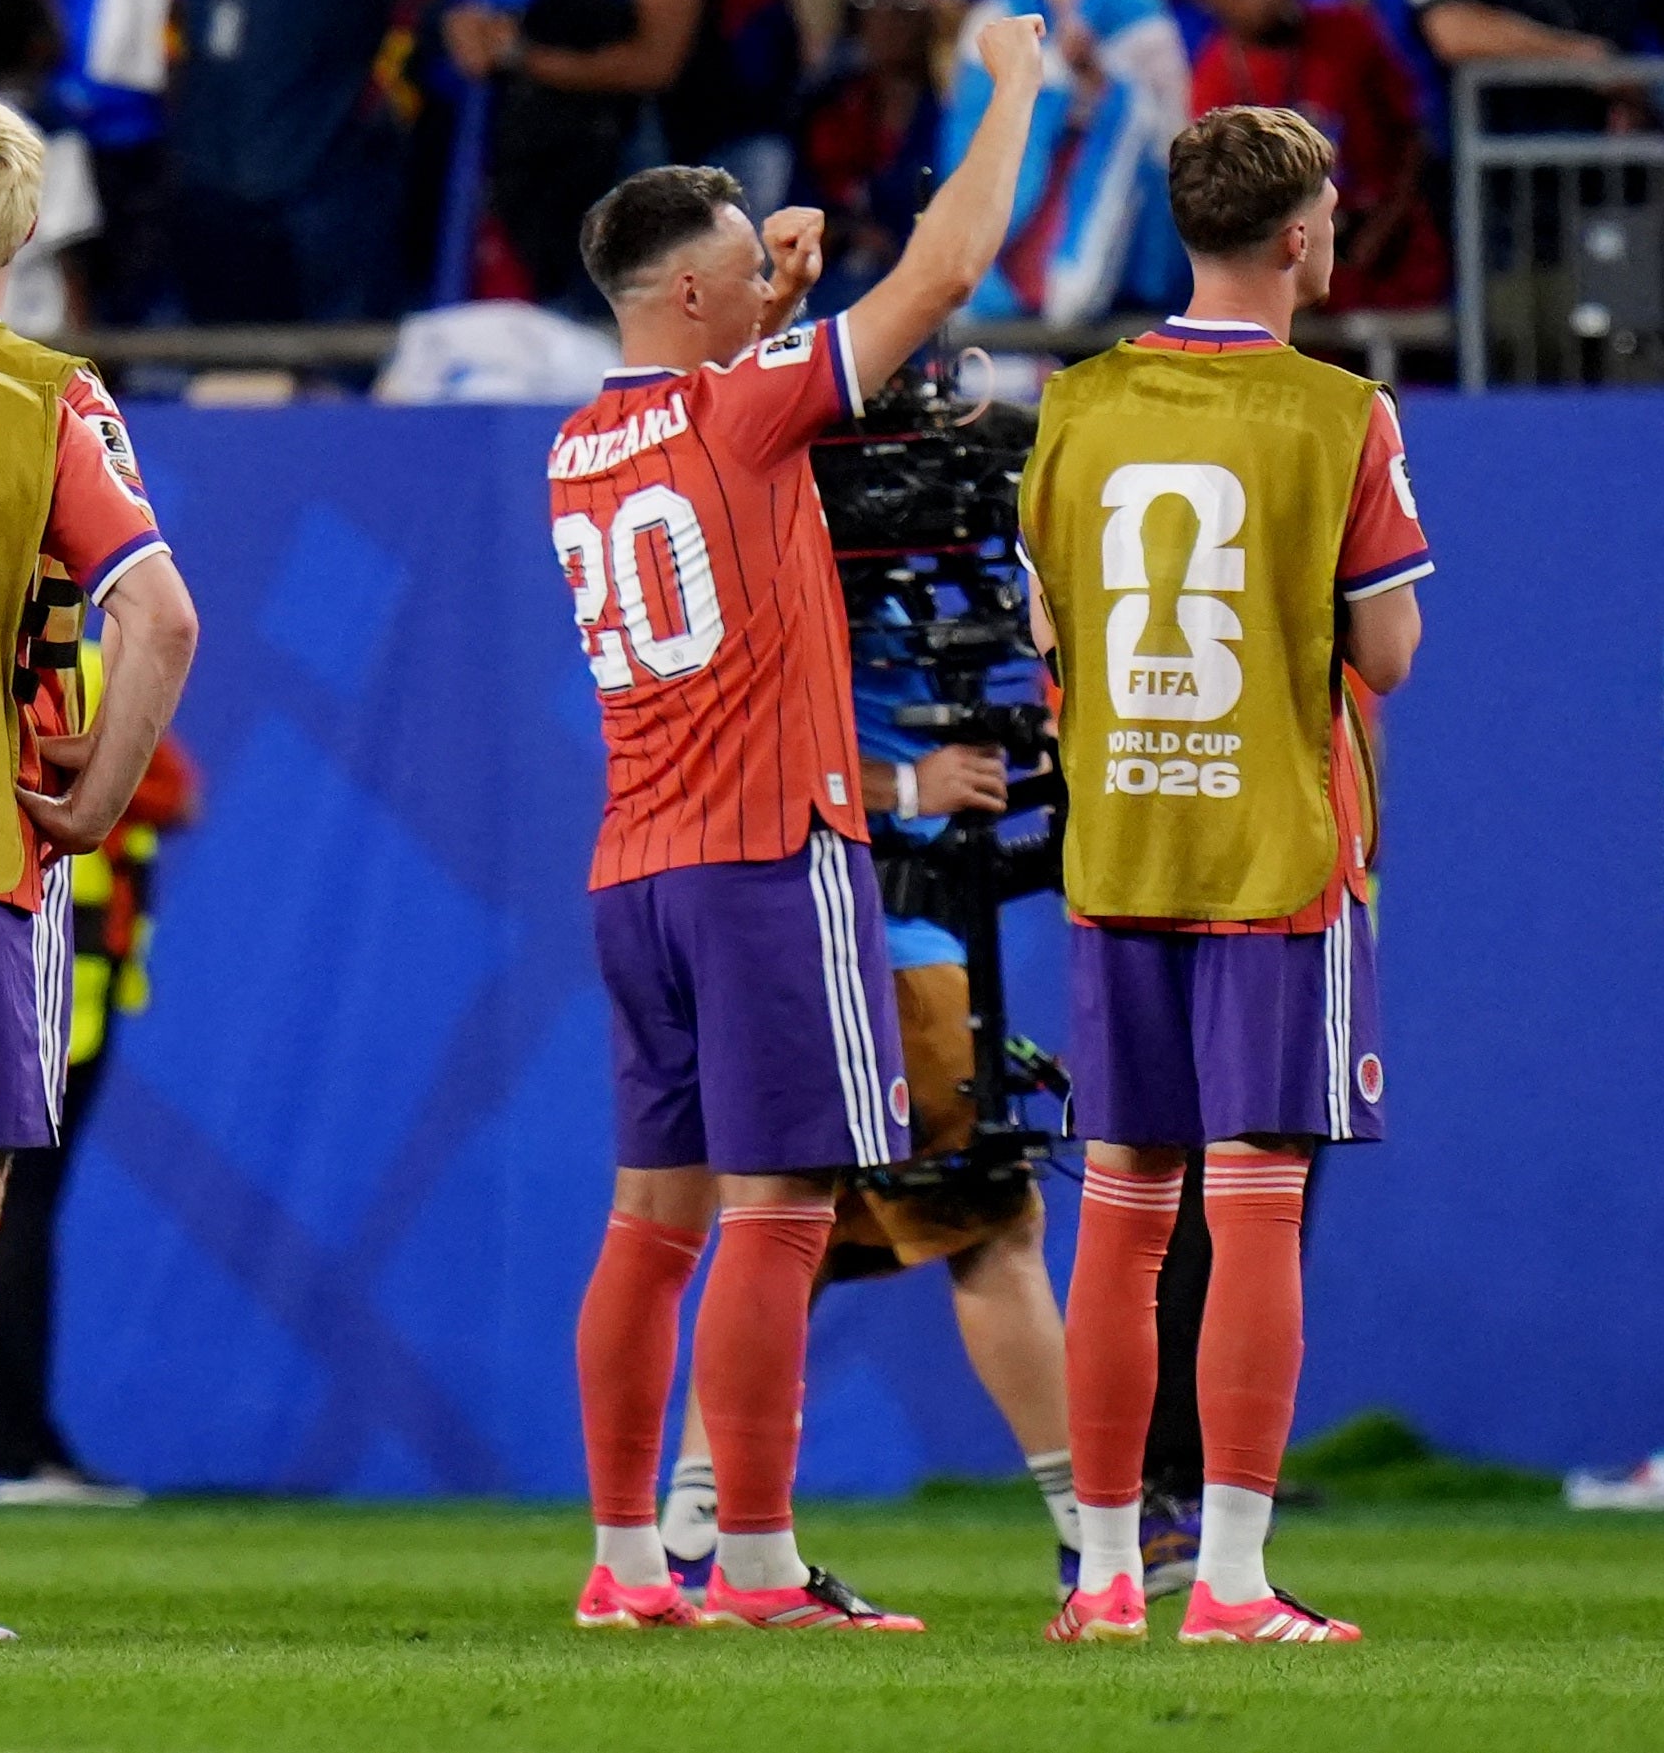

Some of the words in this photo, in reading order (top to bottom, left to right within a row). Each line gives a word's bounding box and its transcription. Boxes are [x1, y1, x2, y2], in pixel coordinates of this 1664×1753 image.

[551, 485, 725, 696] 20
[1128, 669, 1200, 697] FIFA
[1108, 730, 1181, 754] ORLD
[1185, 732, 1242, 756] CUP
